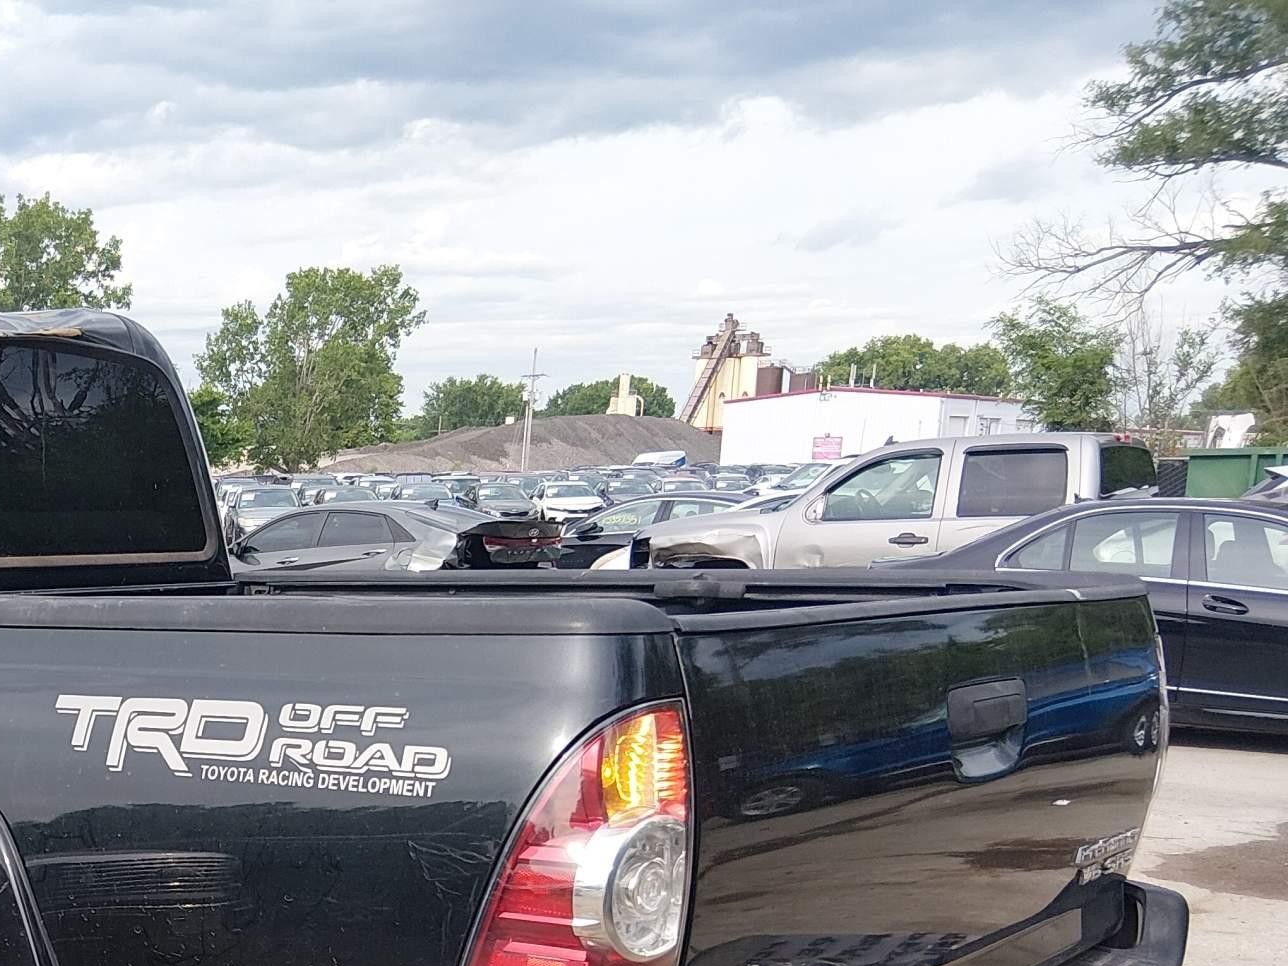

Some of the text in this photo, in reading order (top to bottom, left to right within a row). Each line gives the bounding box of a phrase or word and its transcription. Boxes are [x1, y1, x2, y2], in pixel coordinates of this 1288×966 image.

[55, 694, 268, 777] TRD
[278, 703, 409, 736] OFF
[269, 737, 452, 780] ROAD
[200, 764, 436, 798] TOYOTA RACING DEVELOPMENT
